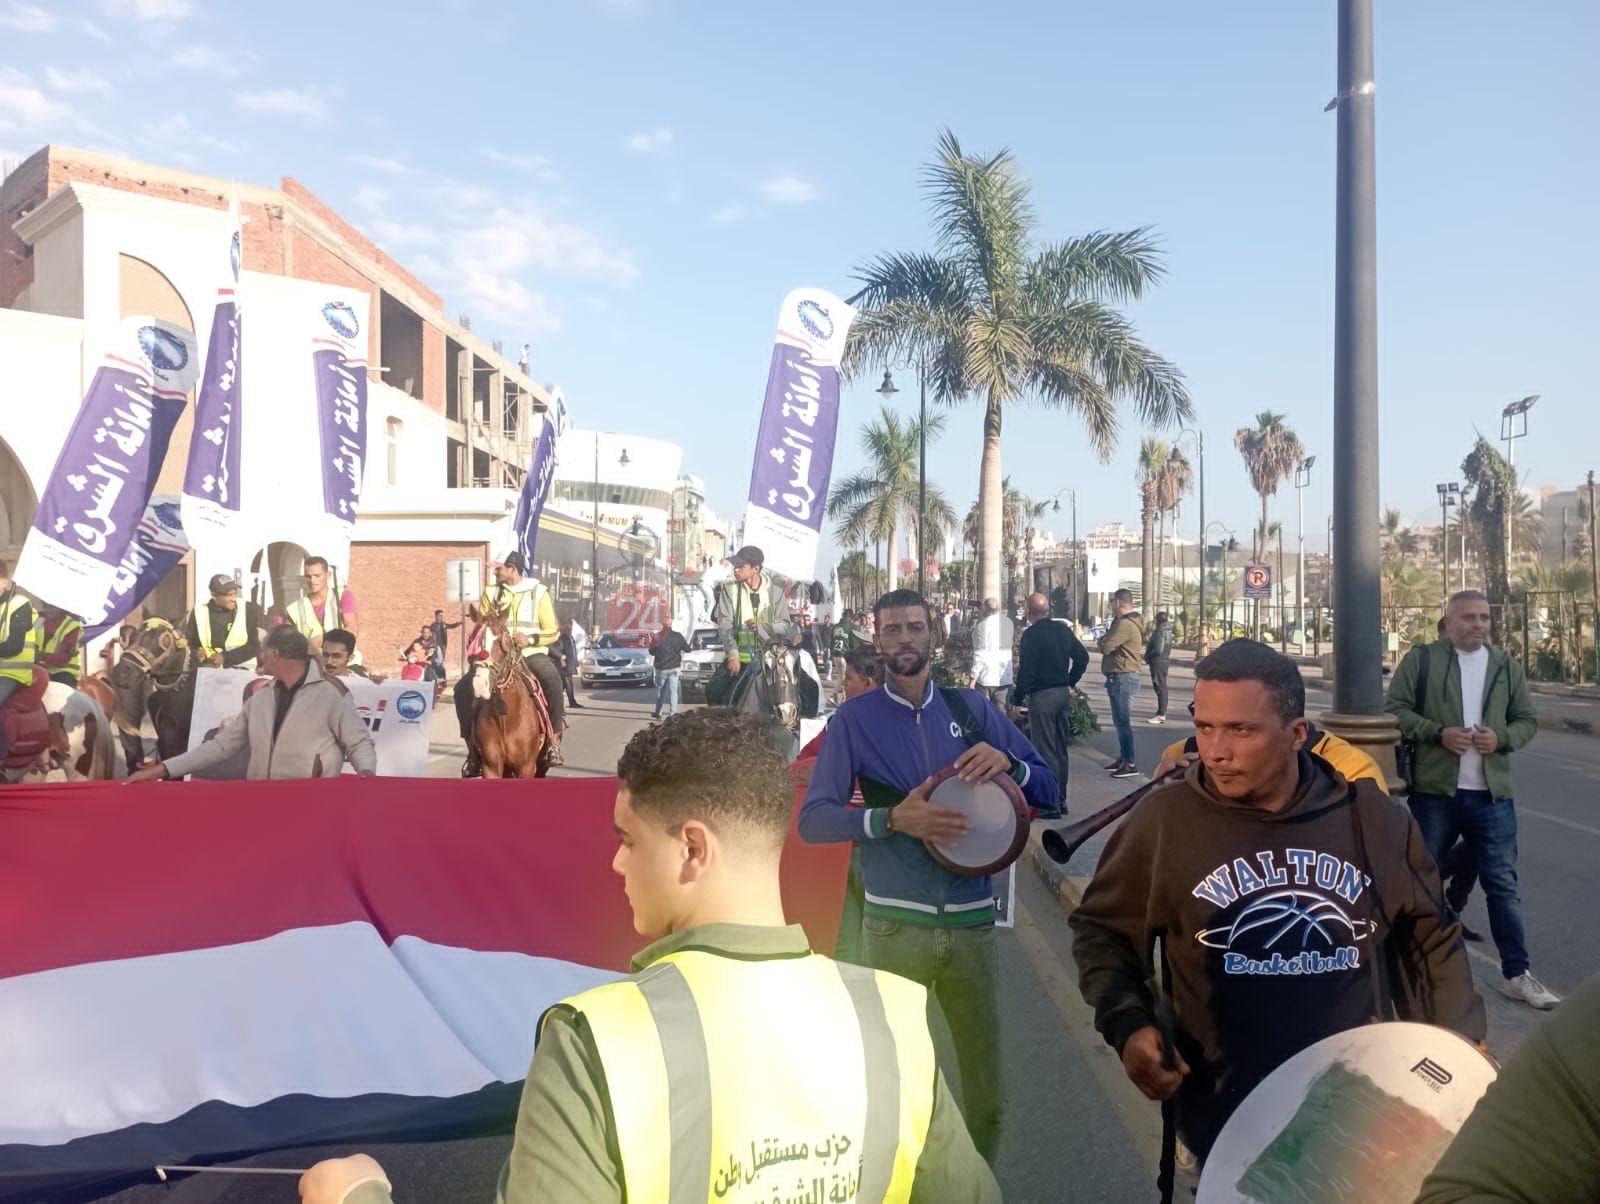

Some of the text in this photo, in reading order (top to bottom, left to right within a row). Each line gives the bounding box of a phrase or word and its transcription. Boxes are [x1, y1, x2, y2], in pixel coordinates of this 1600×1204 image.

[93, 383, 155, 456] أمانة
[782, 357, 824, 426] أمانة
[53, 452, 131, 554] الشرق
[767, 425, 817, 521] الشرق
[1192, 848, 1372, 909] WALTON
[1224, 947, 1360, 975] Basketball
[745, 1137, 809, 1185] مستقبل
[814, 1133, 852, 1167] حزب
